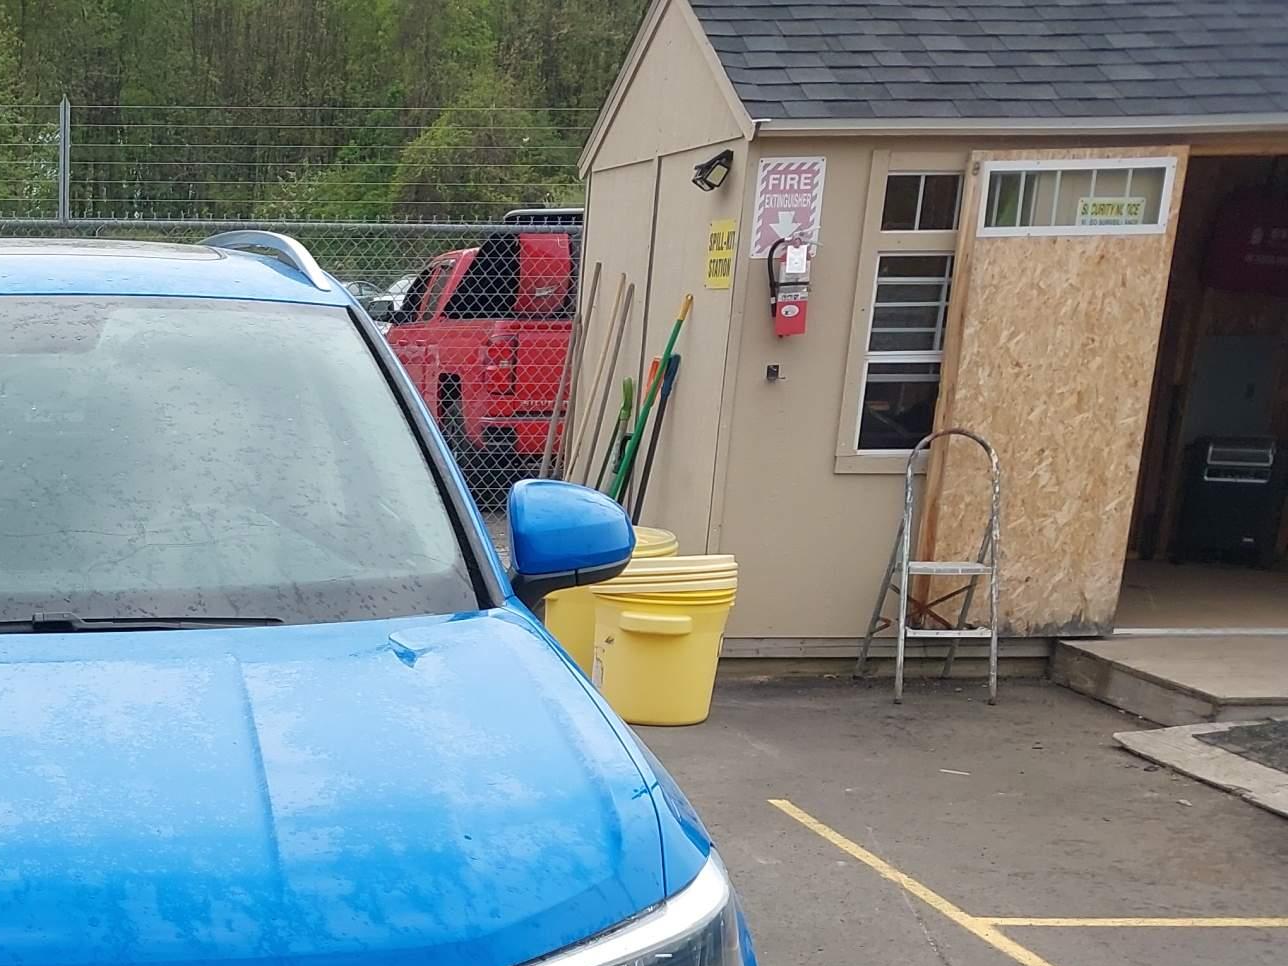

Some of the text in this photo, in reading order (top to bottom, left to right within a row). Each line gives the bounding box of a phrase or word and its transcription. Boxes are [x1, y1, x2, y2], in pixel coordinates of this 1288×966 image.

[768, 173, 813, 190] FIRE
[764, 192, 812, 209] EXTINGUISHER
[708, 230, 736, 251] SPILL-KIT
[707, 257, 731, 278] STATION
